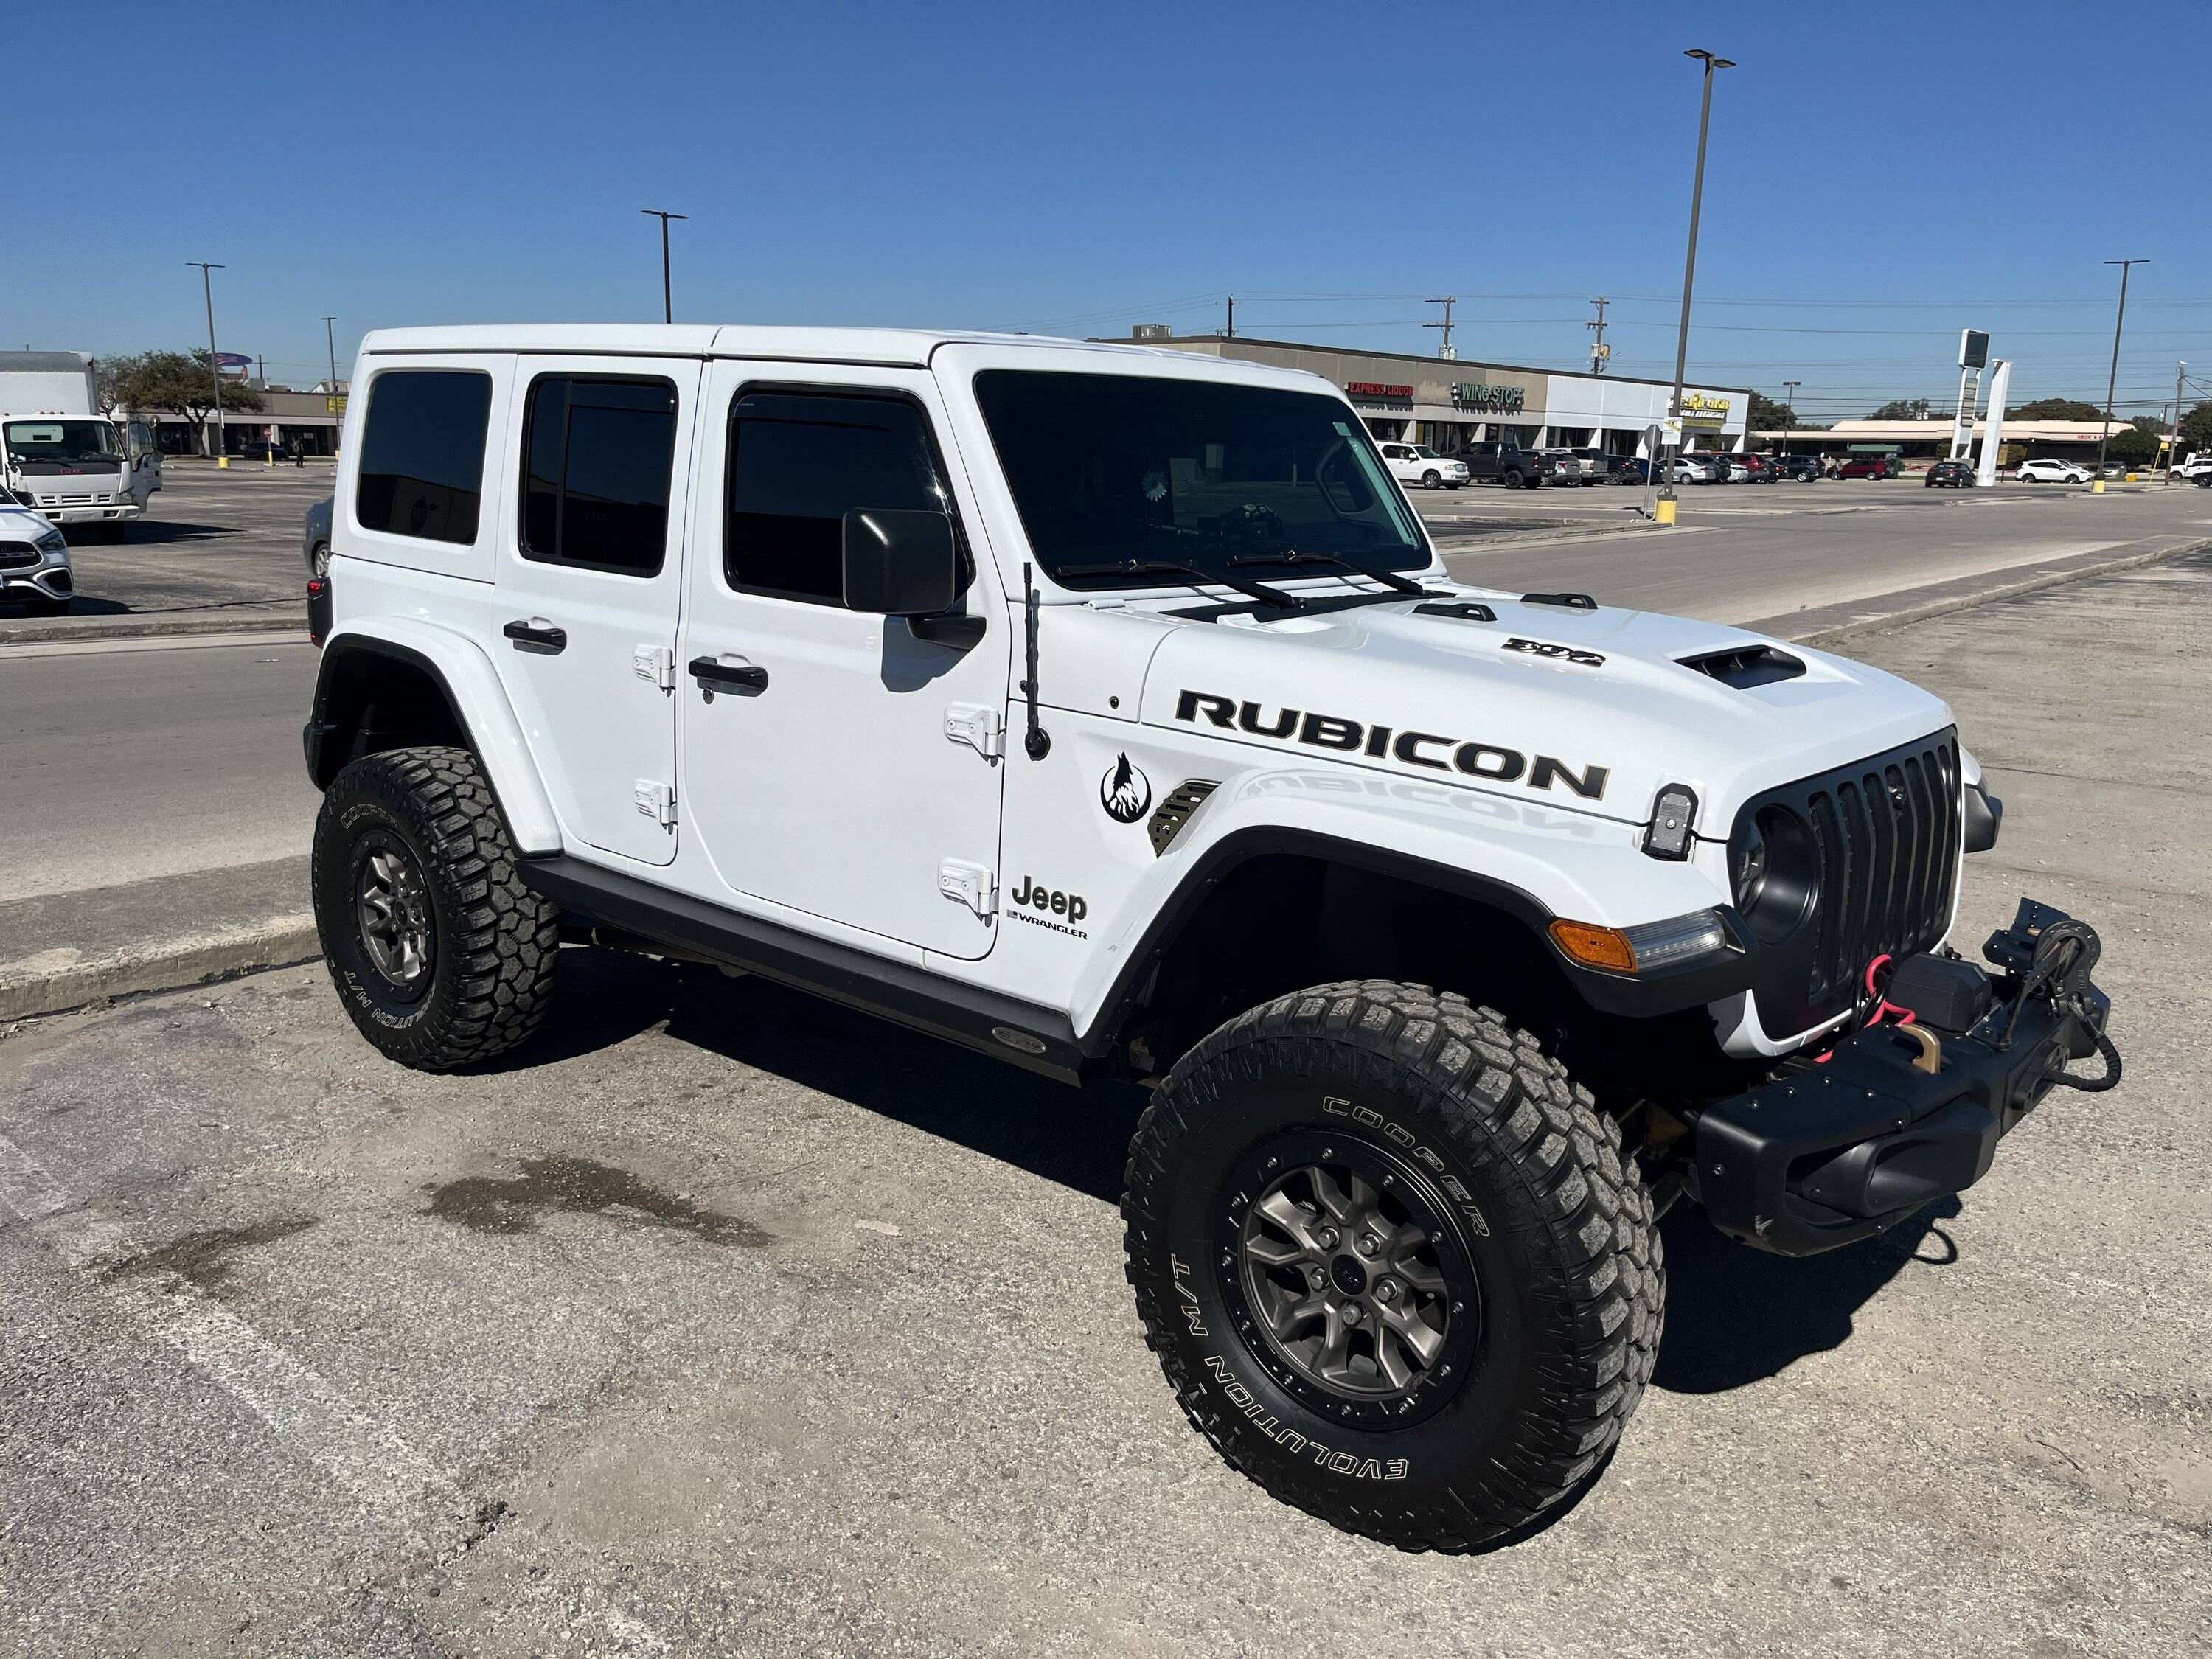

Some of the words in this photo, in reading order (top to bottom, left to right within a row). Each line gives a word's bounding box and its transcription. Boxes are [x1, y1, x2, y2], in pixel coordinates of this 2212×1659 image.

[1350, 382, 1385, 394] EXPRESS
[1387, 386, 1413, 397] LIQUOR
[1175, 689, 1611, 801] RUBICON
[1012, 875, 1088, 925] Jeep
[1018, 912, 1088, 940] WRANGLER
[1322, 1096, 1491, 1237] COOPER
[1171, 1253, 1209, 1336] M/T
[1203, 1354, 1411, 1480] EVOLUTION
